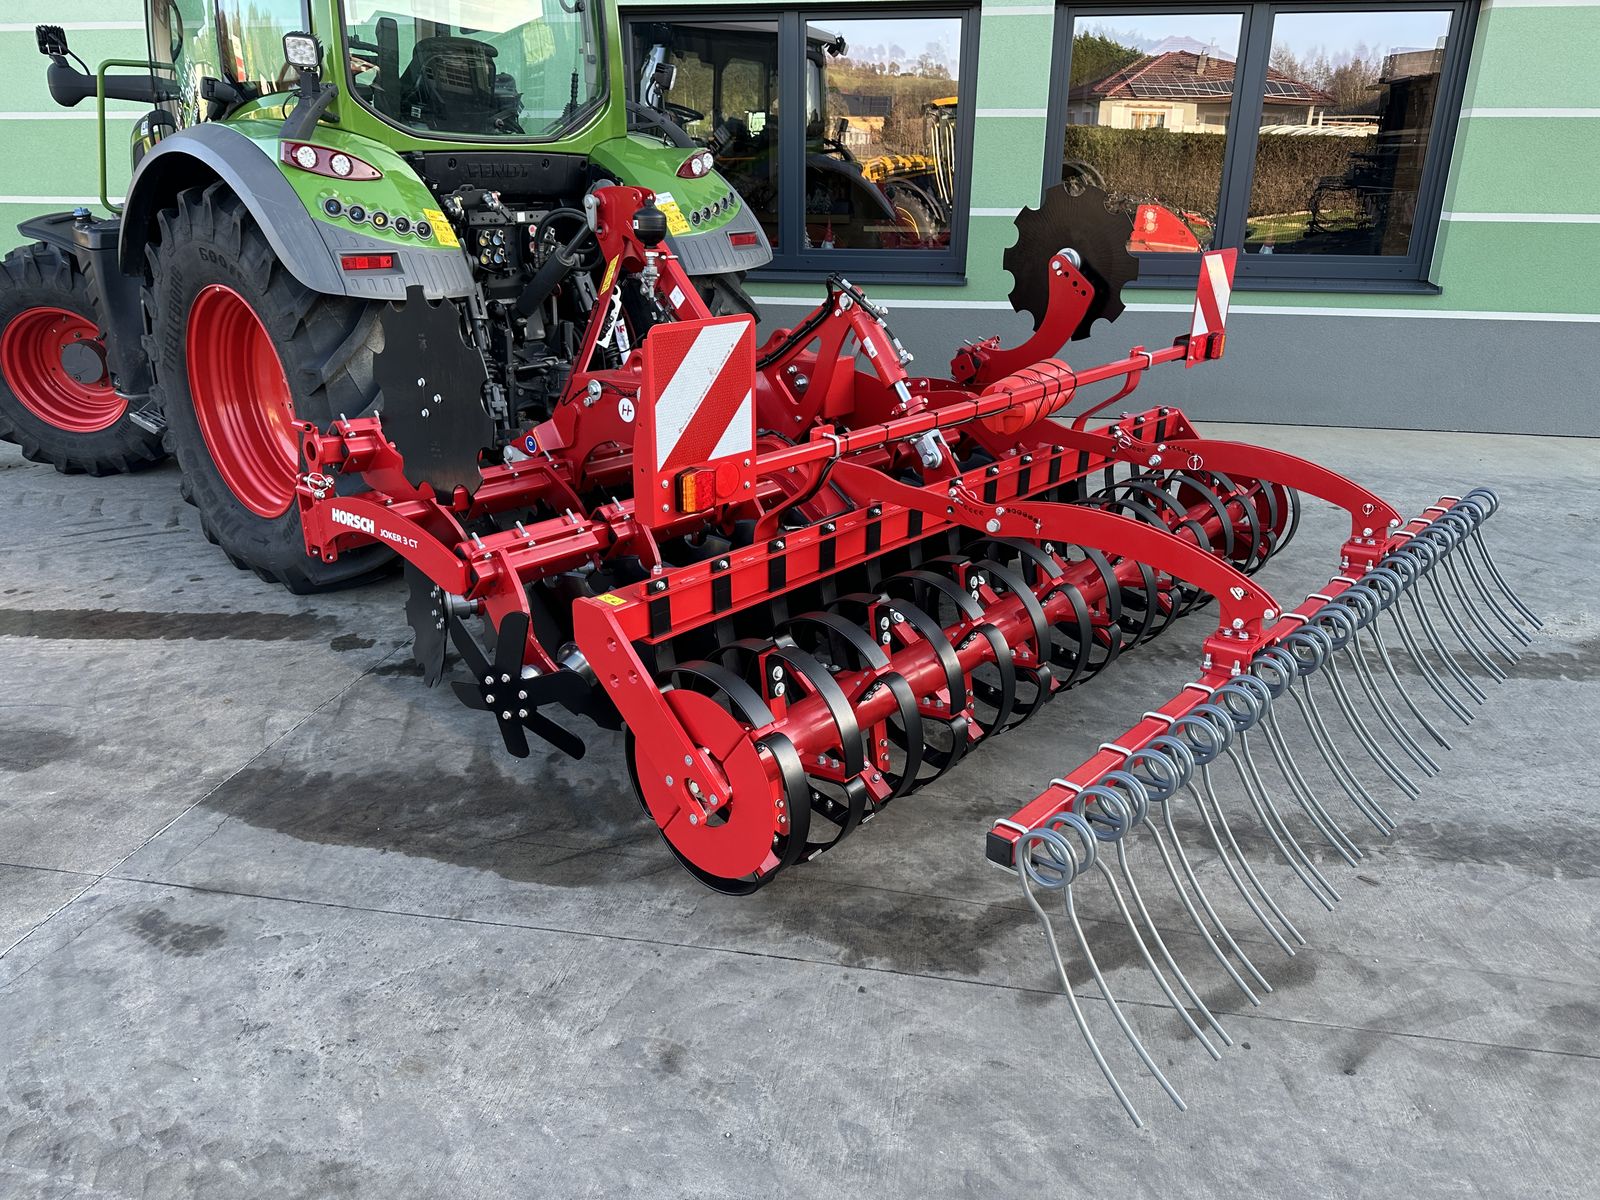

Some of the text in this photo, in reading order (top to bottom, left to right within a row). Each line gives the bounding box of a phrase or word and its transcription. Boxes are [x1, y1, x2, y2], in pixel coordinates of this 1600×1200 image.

[466, 162, 533, 178] FENDT
[198, 247, 228, 269] 600
[162, 264, 184, 372] TRELLEBORG
[331, 508, 418, 548] HORSCH JOKER 3 CT
